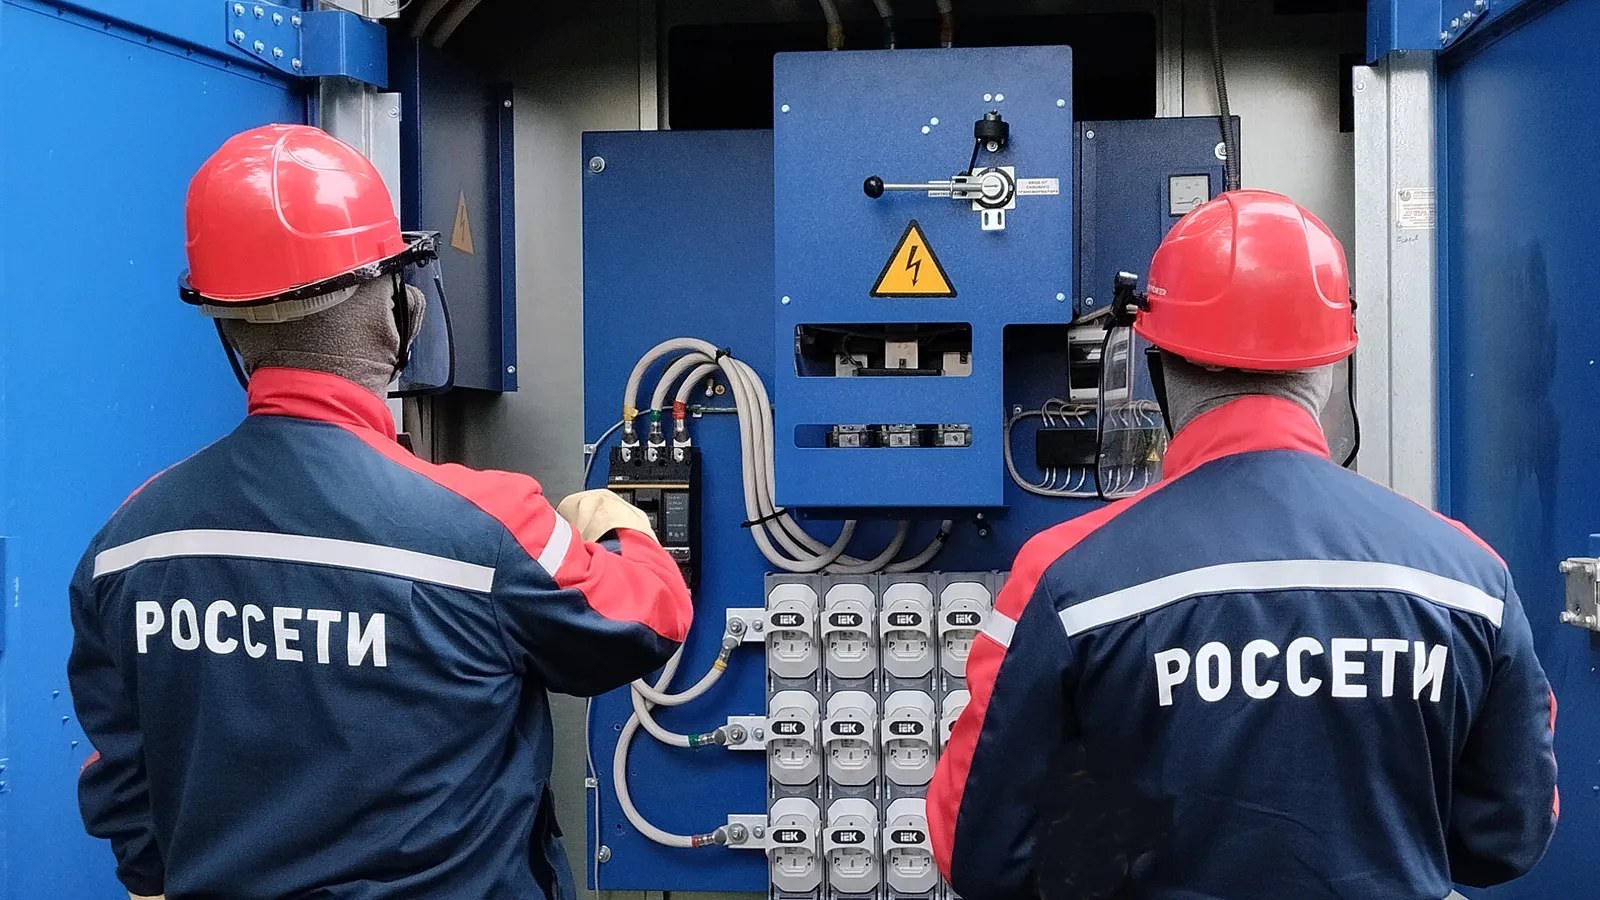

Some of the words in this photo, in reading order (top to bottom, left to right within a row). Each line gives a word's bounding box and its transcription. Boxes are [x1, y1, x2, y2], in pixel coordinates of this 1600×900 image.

[780, 615, 797, 624] IEK
[838, 615, 855, 624] IEK
[897, 614, 914, 624] IEK
[956, 614, 973, 623] IEK
[135, 598, 387, 667] РОССЕТИ
[1153, 636, 1448, 706] РОССЕТИ
[781, 723, 798, 732] IEK
[839, 723, 857, 733] IEK
[898, 723, 916, 733] IEK
[782, 832, 799, 841] IEK
[841, 832, 858, 841] IEK
[901, 832, 918, 841] IEK
